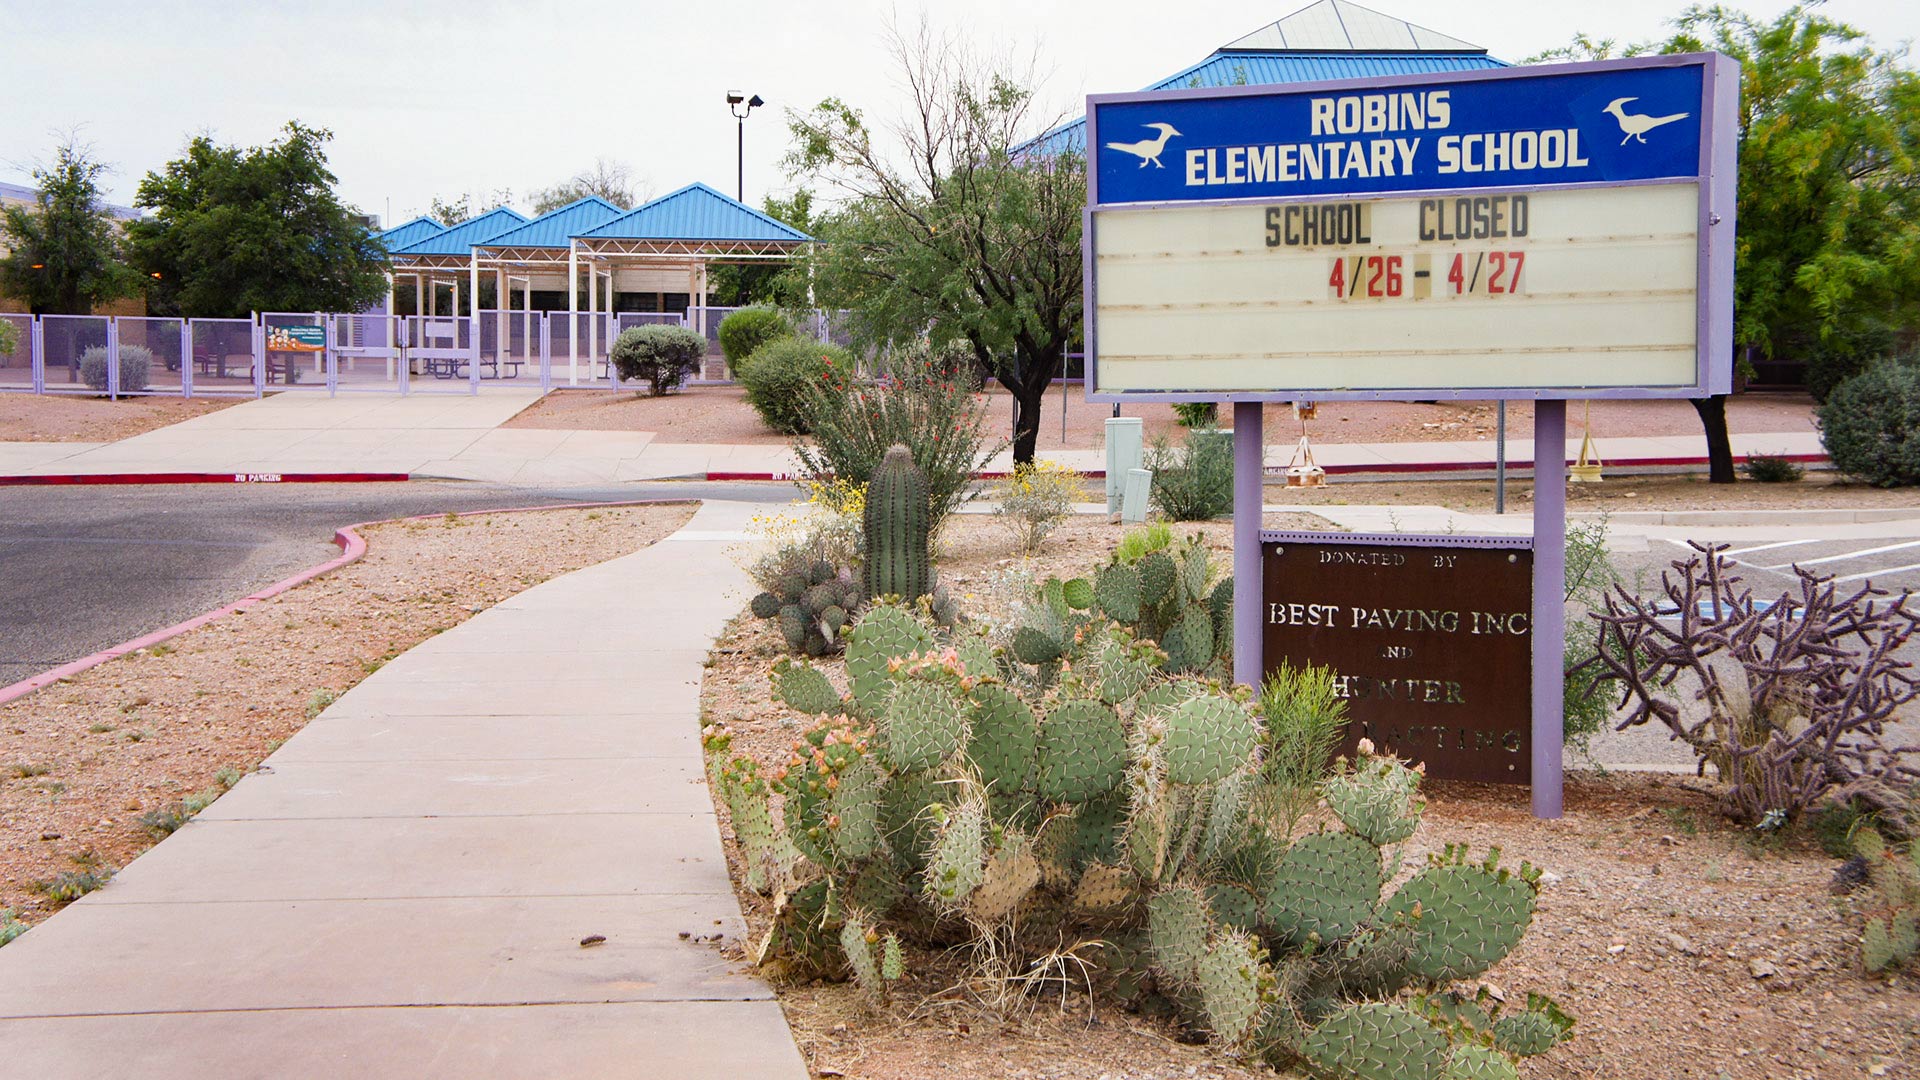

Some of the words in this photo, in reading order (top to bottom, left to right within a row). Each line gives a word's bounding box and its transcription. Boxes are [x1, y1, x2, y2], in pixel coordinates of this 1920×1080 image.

[1311, 90, 1451, 136] ROBINS
[1185, 137, 1421, 186] ELEMENTARY
[1437, 128, 1589, 174] SCHOOL
[1265, 203, 1372, 247] SCHOOL
[1419, 195, 1529, 242] CLOSED
[1328, 255, 1403, 298] 4/26
[1447, 251, 1526, 295] 4/27
[235, 474, 246, 482] NO
[248, 474, 281, 482] PARKING
[1319, 550, 1405, 567] DONATED
[1433, 555, 1457, 568] BY
[1269, 602, 1339, 627] BEST
[1351, 607, 1459, 632] PAVING
[1470, 611, 1528, 635] INC
[1378, 646, 1414, 660] AND
[1331, 675, 1466, 704] HUNTER
